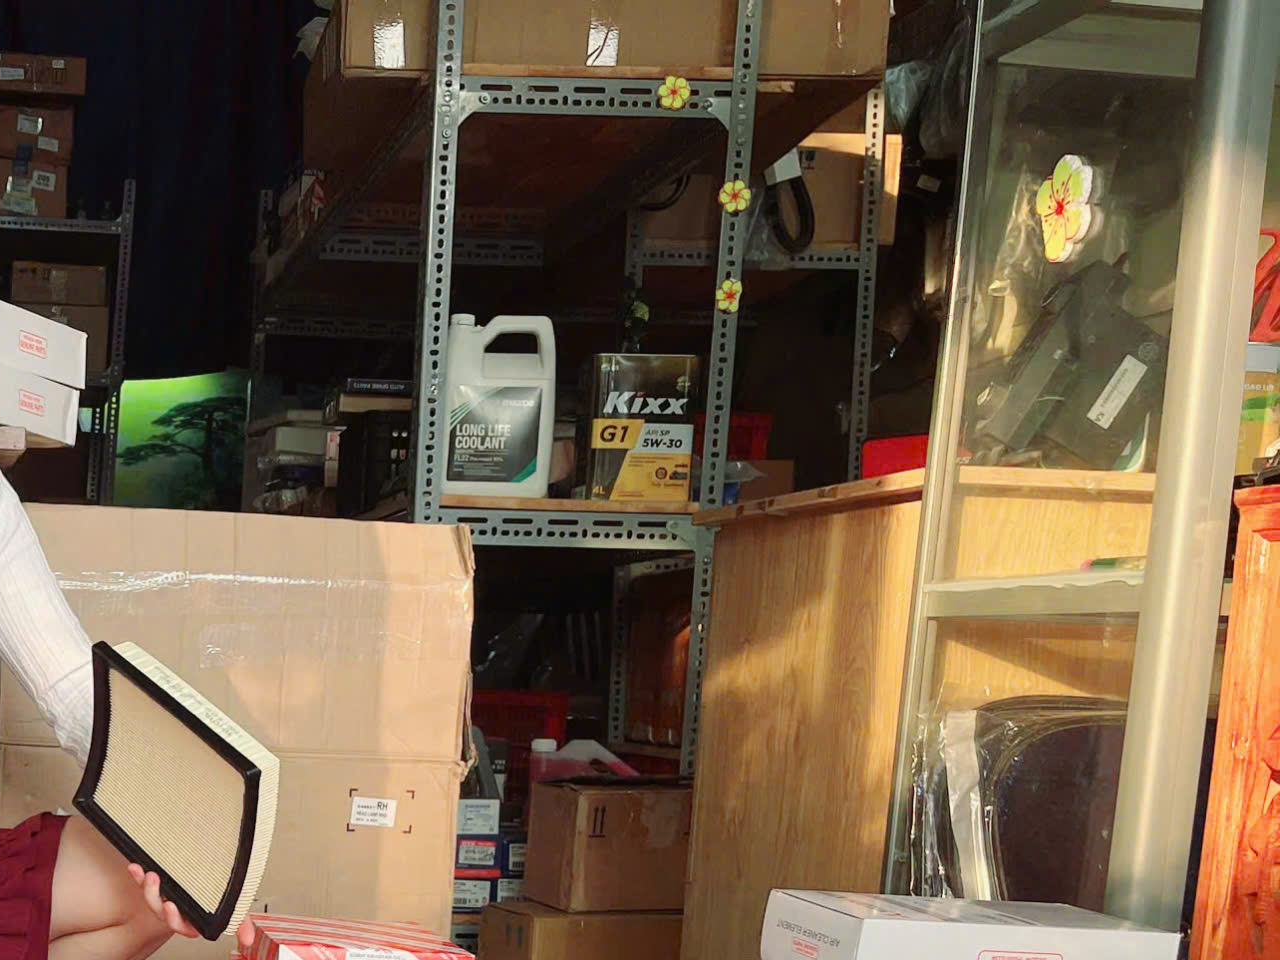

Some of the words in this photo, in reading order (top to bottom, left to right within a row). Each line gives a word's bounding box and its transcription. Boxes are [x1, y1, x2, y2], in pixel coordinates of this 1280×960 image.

[603, 391, 688, 415] Kixx
[456, 423, 485, 437] LONG
[488, 424, 512, 437] LIFE
[600, 425, 629, 443] G1
[455, 436, 507, 450] COOLANT
[642, 438, 683, 449] 5W-30
